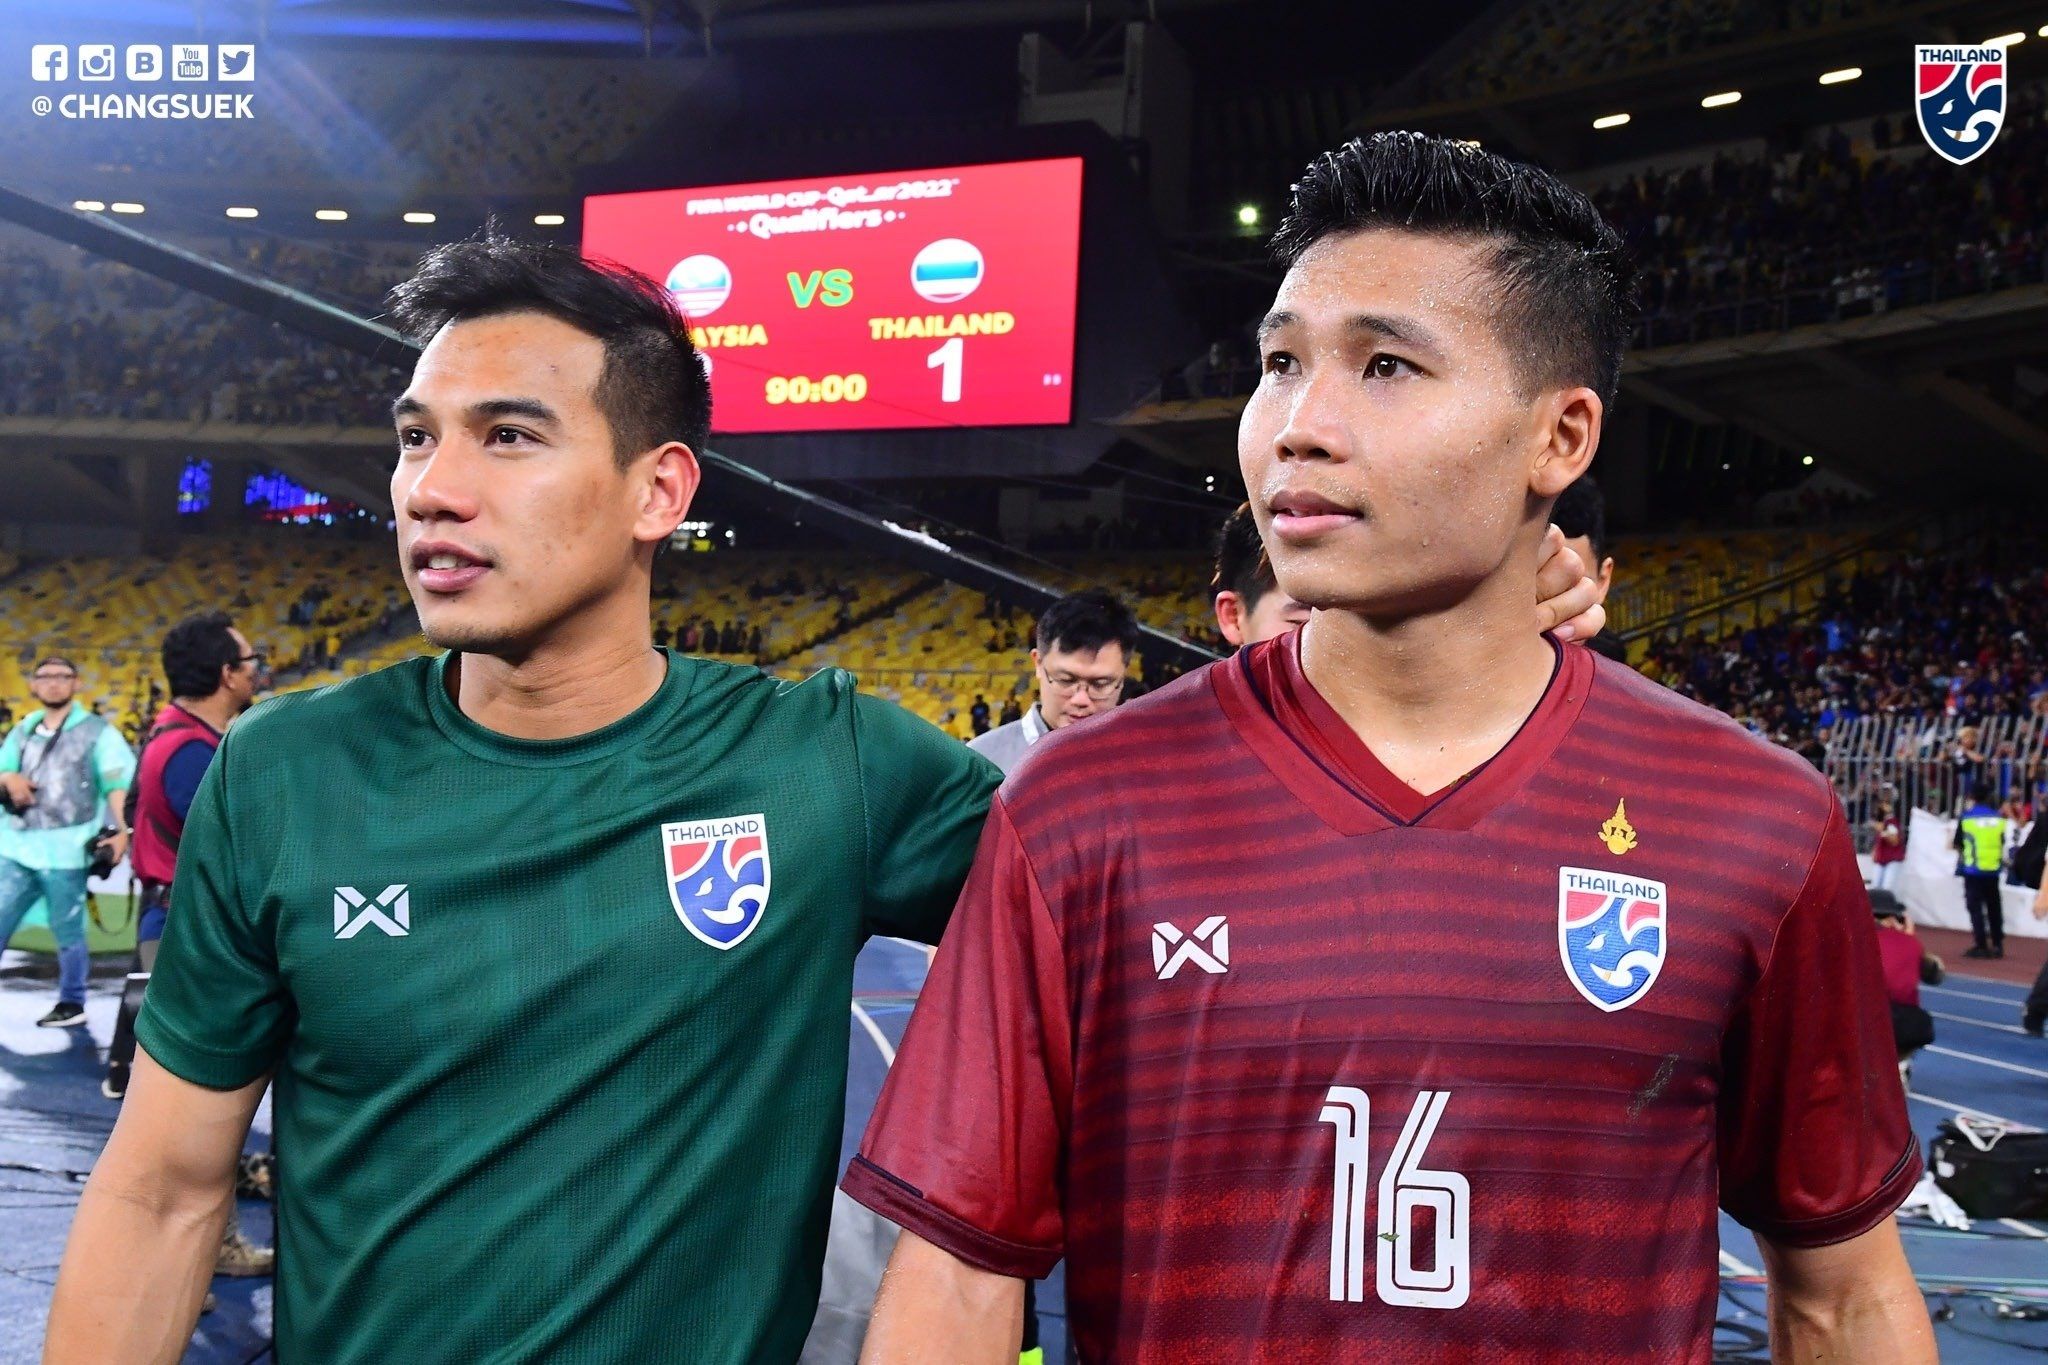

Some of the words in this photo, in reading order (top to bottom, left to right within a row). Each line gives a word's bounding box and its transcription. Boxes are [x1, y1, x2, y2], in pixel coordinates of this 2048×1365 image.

[750, 207, 882, 238] Qualifiers
[787, 268, 854, 308] VS
[689, 323, 769, 348] AYSIA
[868, 311, 1015, 341] THAILAND
[926, 337, 964, 403] 1
[765, 374, 868, 405] 90:00
[668, 820, 759, 842] THAILAND
[1567, 873, 1660, 900] THAILAND
[1318, 1085, 1471, 1310] 16
